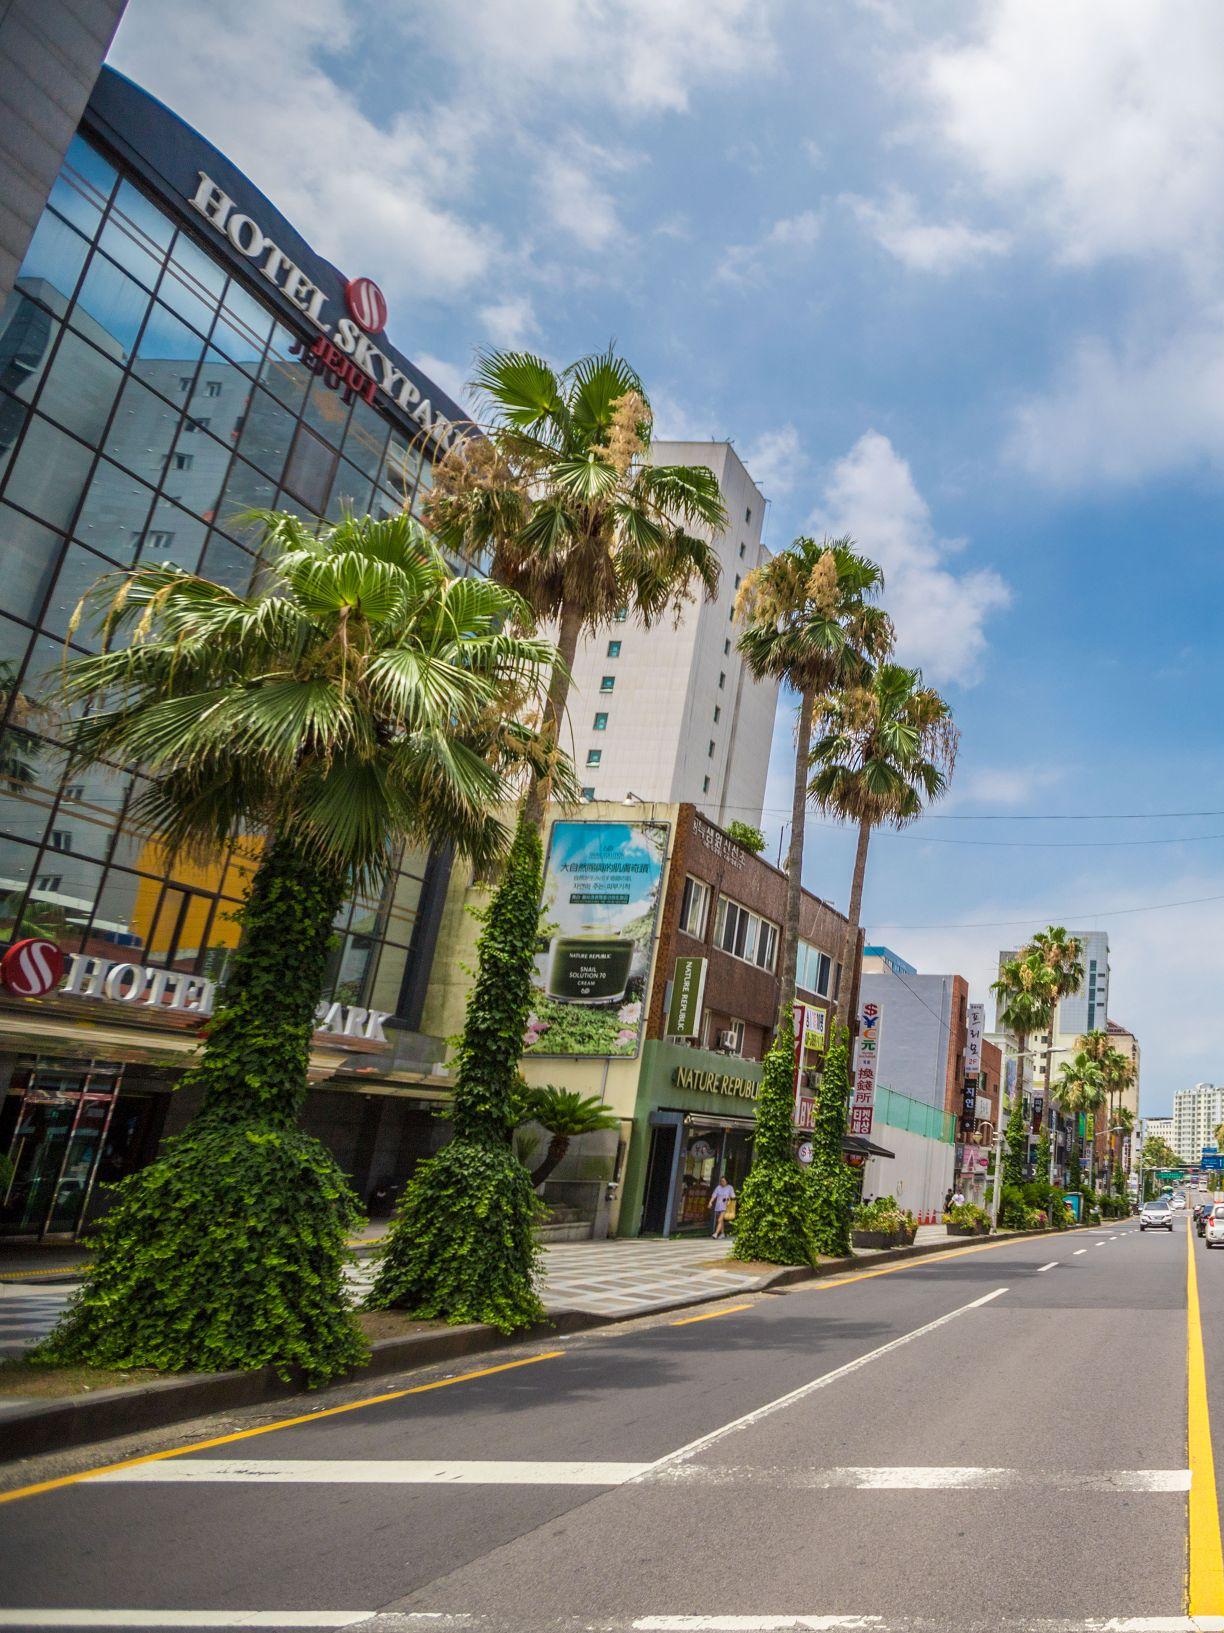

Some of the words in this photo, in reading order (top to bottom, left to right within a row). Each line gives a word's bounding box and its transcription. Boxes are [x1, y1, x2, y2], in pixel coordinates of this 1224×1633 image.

[188, 171, 332, 331] HOTEL
[311, 335, 364, 392] JEJU
[682, 960, 693, 995] NATURE
[677, 994, 689, 1032] REPUBLIC
[676, 1066, 720, 1095] NATURE
[720, 1075, 760, 1100] REPUBLI
